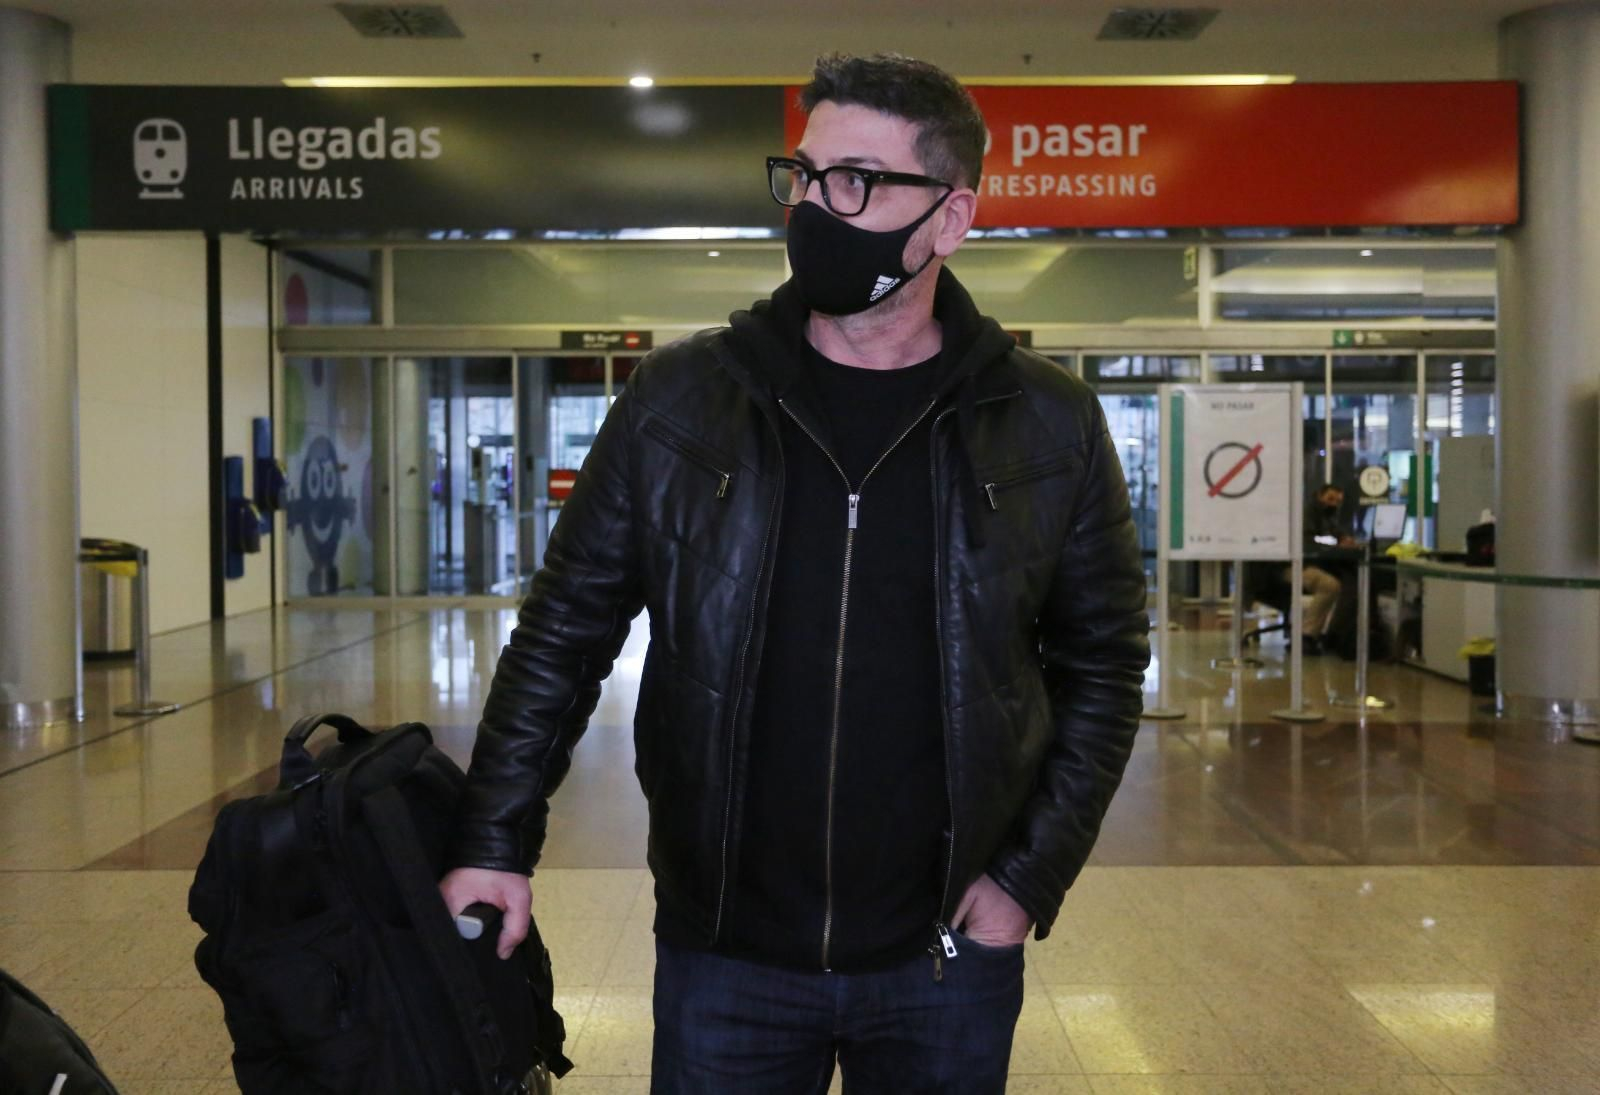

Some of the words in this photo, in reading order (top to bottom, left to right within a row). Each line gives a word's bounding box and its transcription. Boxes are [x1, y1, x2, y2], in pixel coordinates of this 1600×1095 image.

[228, 116, 442, 170] Llegadas
[1012, 124, 1147, 167] pasar
[230, 176, 364, 199] ARRIVALS
